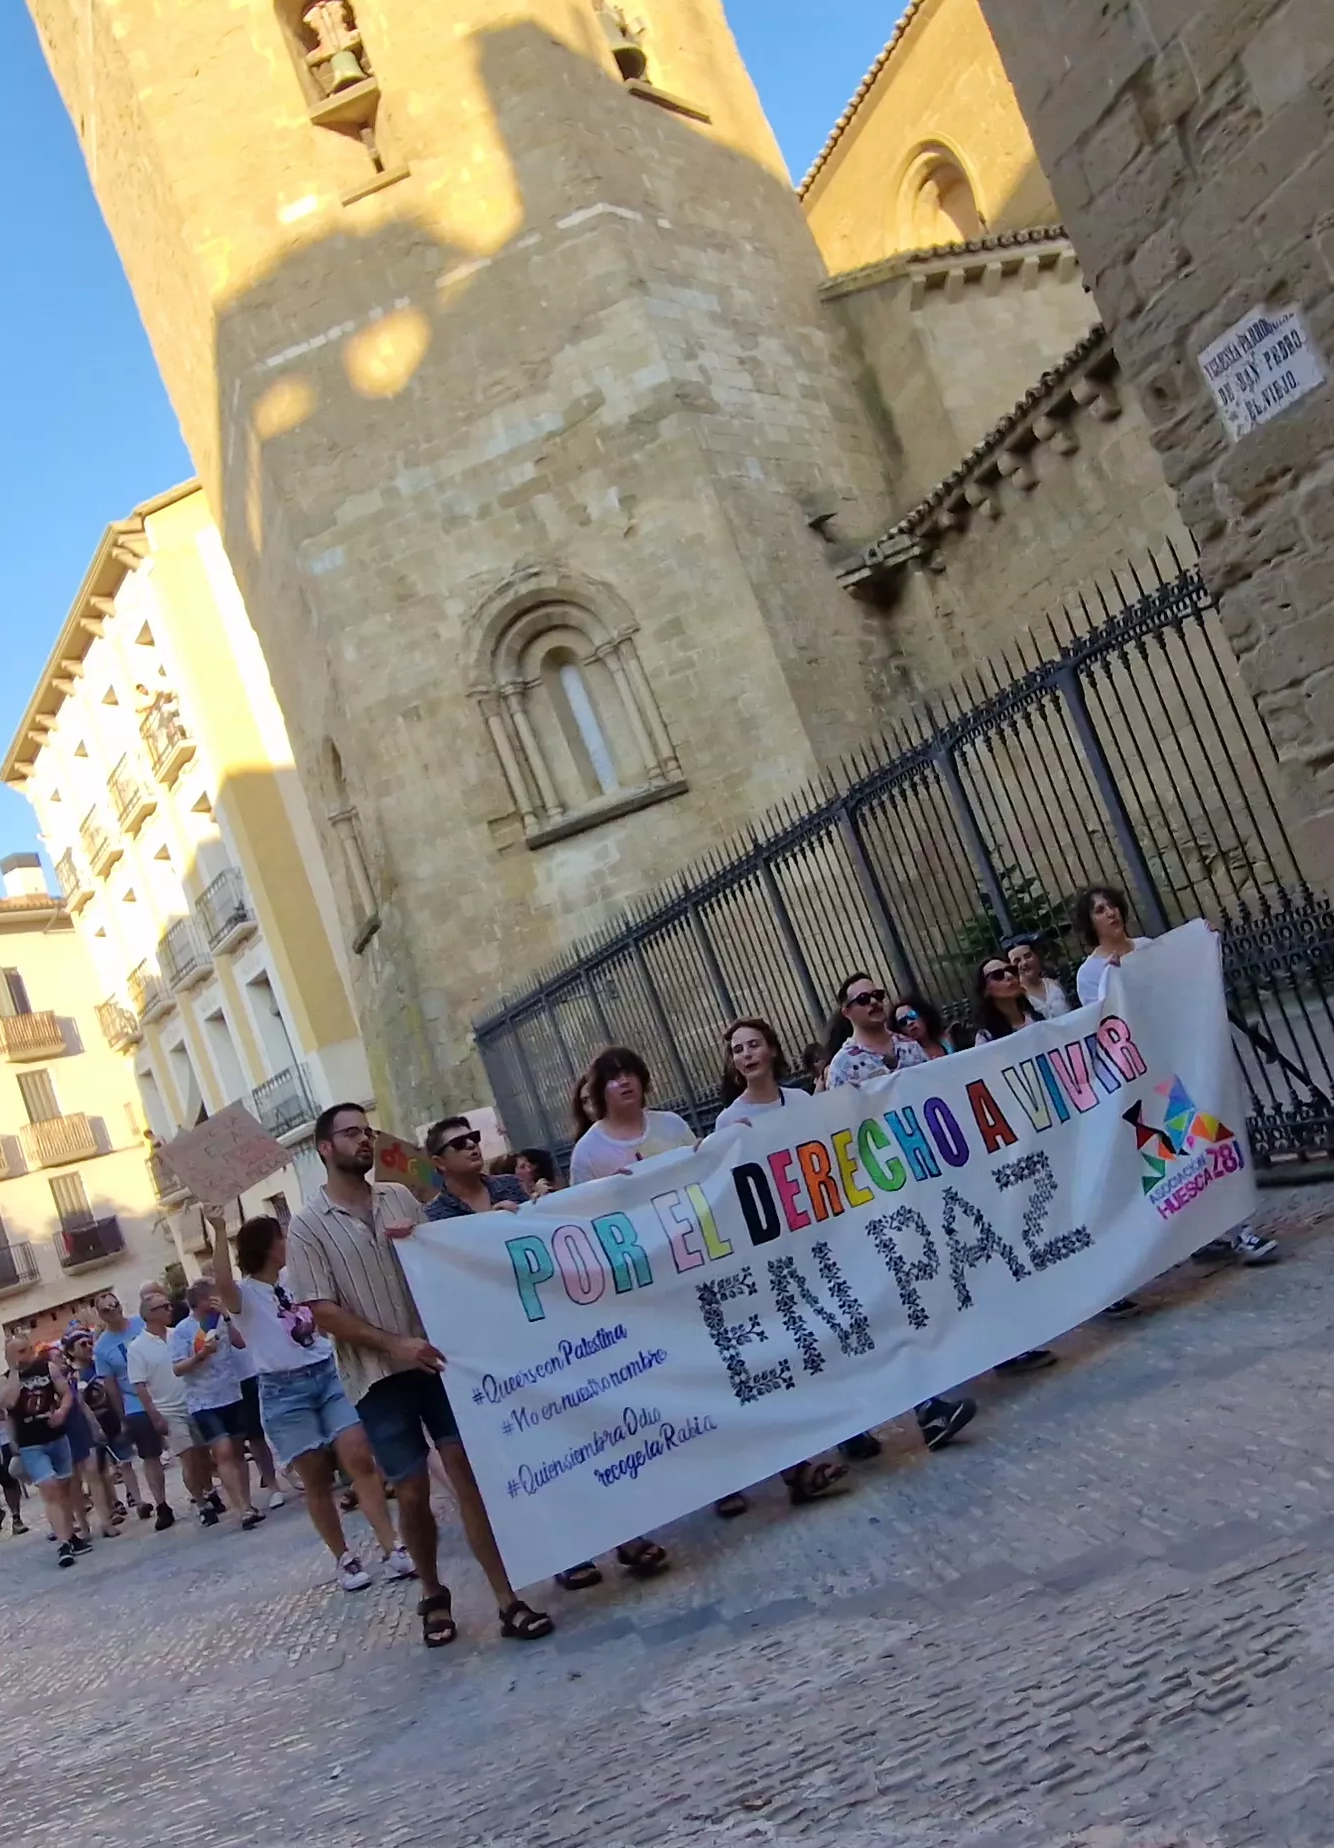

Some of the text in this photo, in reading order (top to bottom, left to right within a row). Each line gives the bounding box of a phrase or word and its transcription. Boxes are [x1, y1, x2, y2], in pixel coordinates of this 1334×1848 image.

[1218, 329, 1303, 406] DE SAN PEDRO
[1244, 400, 1263, 421] EL
[505, 1014, 1148, 1322] POR EL DERECHO A VIVIR
[695, 1150, 1095, 1406] EN PAZ
